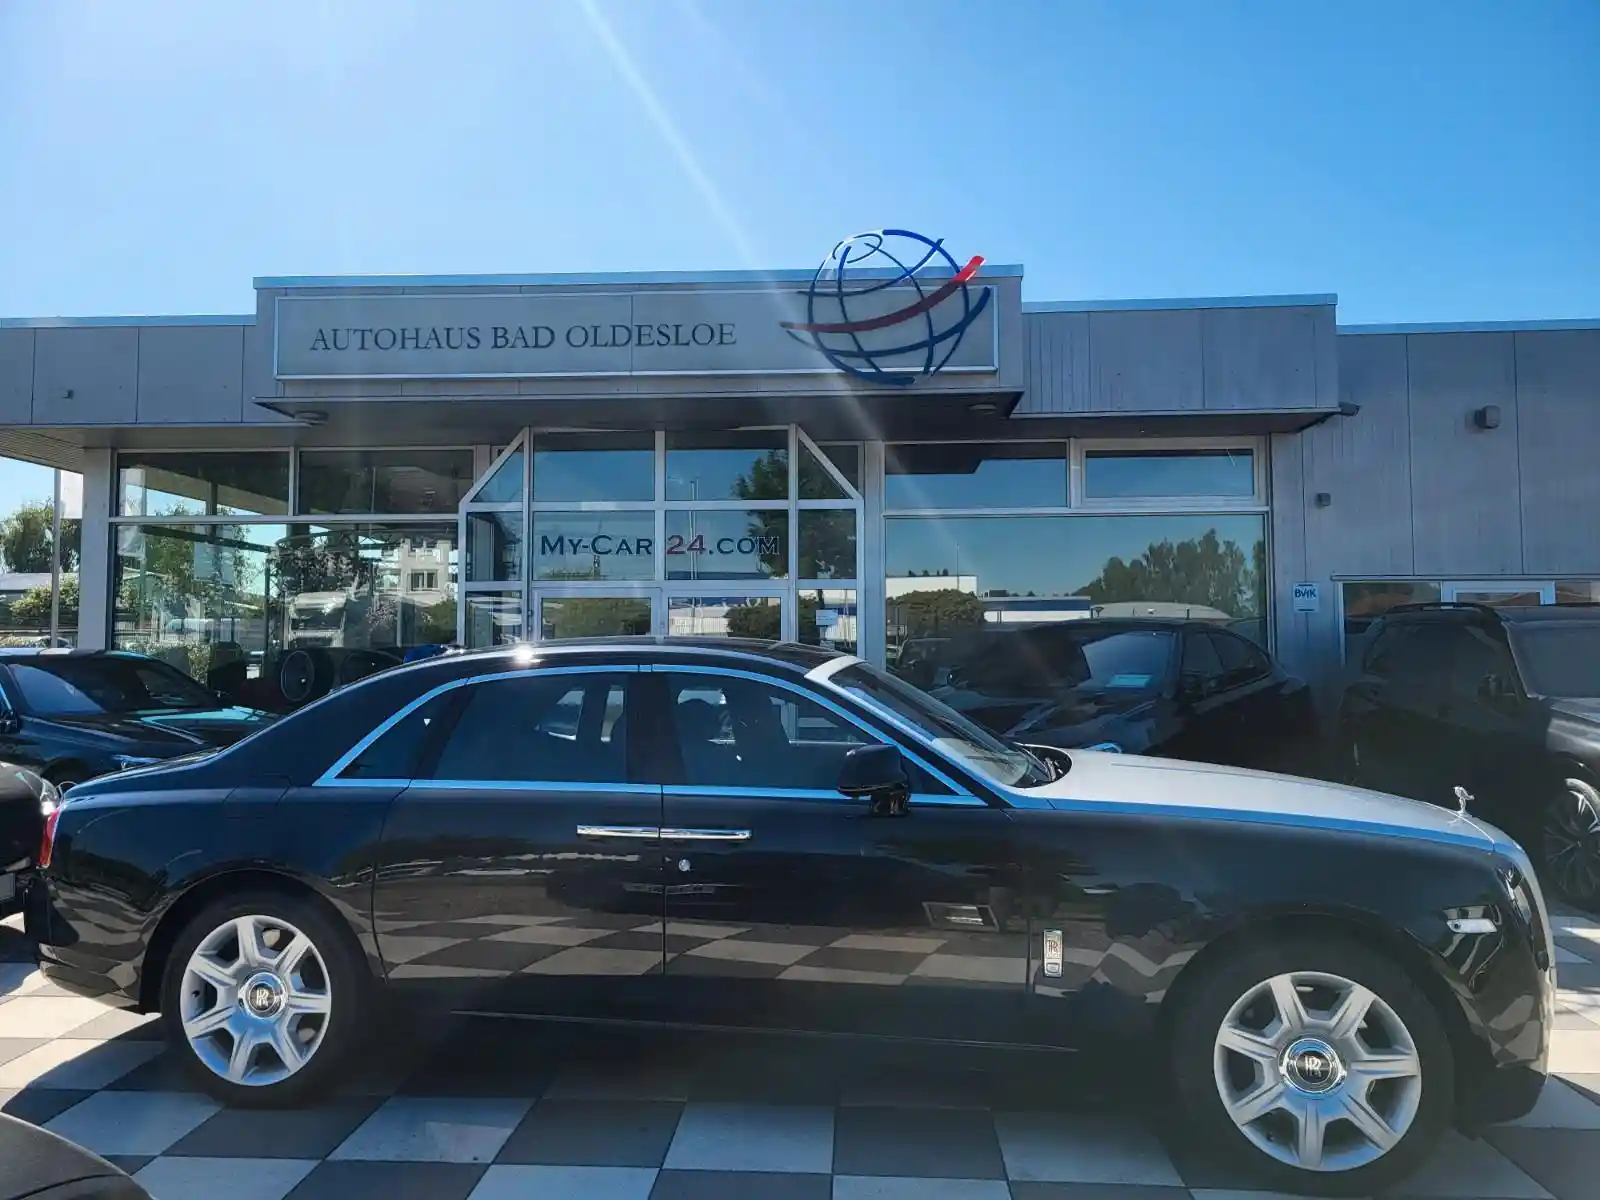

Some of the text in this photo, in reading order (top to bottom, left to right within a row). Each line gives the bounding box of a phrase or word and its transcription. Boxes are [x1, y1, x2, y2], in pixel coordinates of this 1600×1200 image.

[310, 322, 737, 351] AUTOHAUS BAD OLDESLOE
